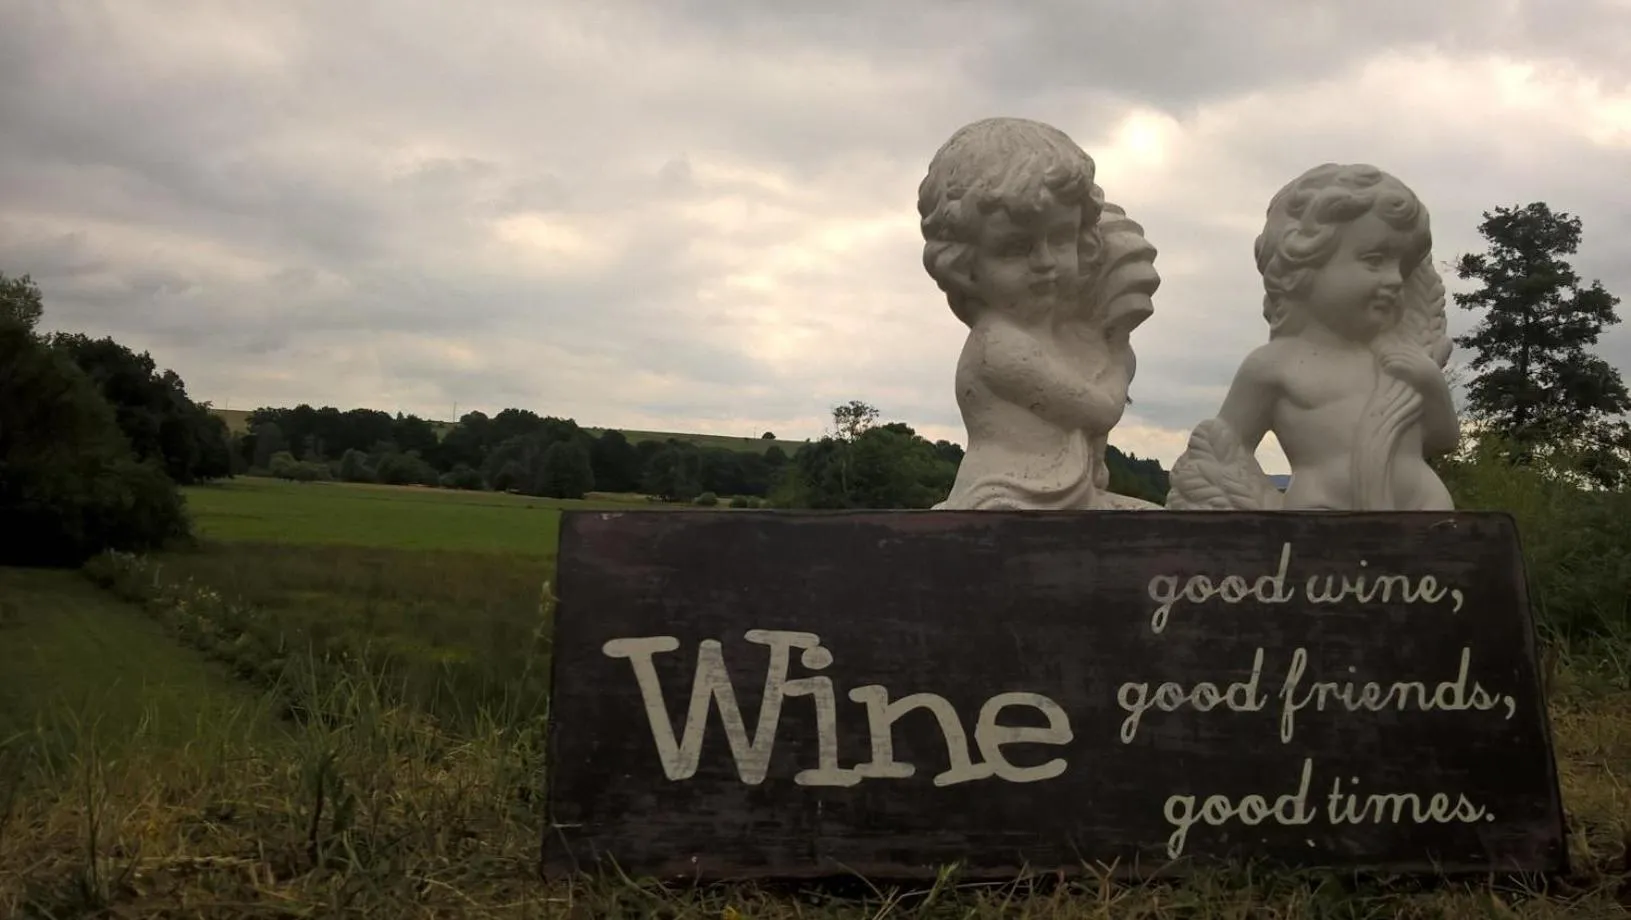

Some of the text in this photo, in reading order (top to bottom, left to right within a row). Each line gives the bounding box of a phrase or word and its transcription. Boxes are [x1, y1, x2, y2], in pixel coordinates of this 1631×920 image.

[1148, 542, 1464, 634] good wine,
[602, 629, 1074, 787] Wine
[1117, 647, 1517, 744] good friends,
[1164, 758, 1496, 858] good times.
